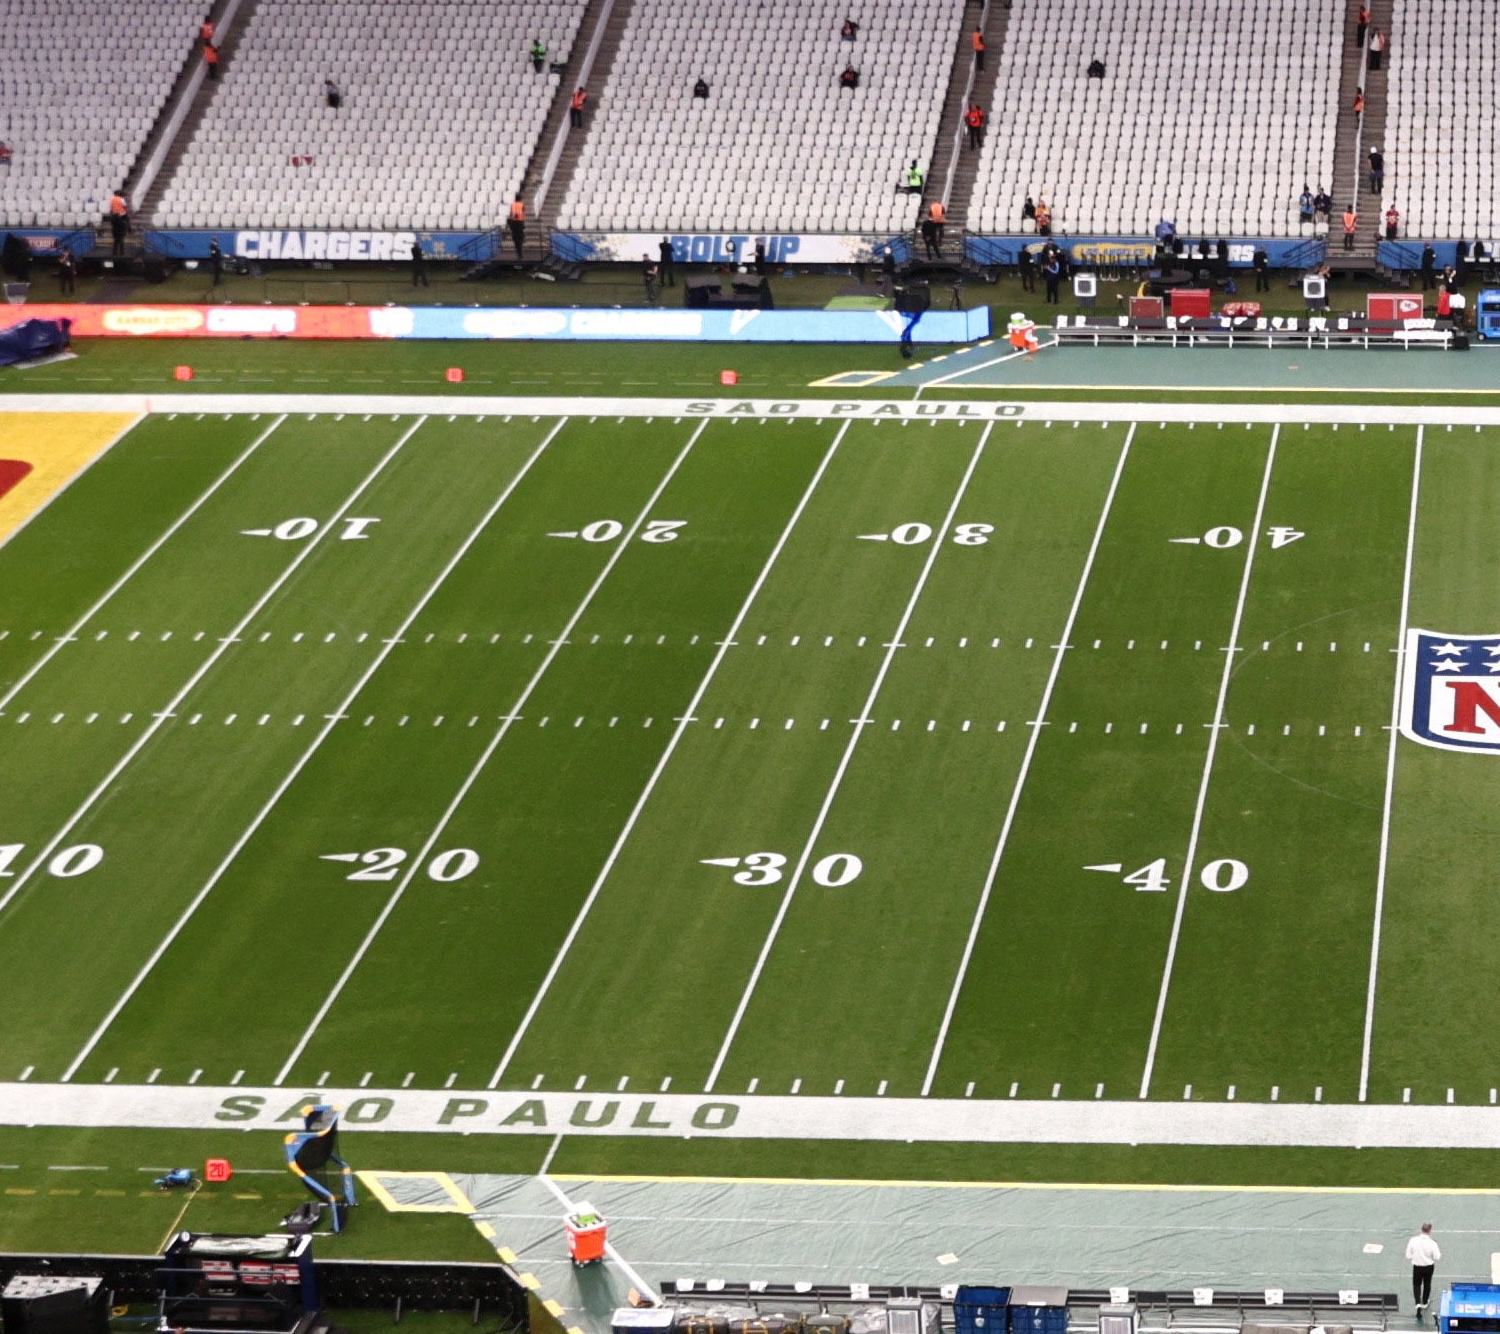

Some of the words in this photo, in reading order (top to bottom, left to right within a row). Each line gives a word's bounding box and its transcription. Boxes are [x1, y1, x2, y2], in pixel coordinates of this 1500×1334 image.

[236, 231, 416, 260] CHARGERS
[670, 236, 749, 263] BOLT
[831, 403, 1026, 417] PAULO
[274, 515, 383, 541] 10
[581, 519, 689, 545] 20
[888, 522, 996, 546] 30
[1203, 525, 1306, 550] 40
[346, 847, 482, 884] 20
[733, 851, 864, 889] 30
[1123, 858, 1250, 893] 40
[437, 1098, 740, 1130] PAULO
[209, 1163, 224, 1178] 20
